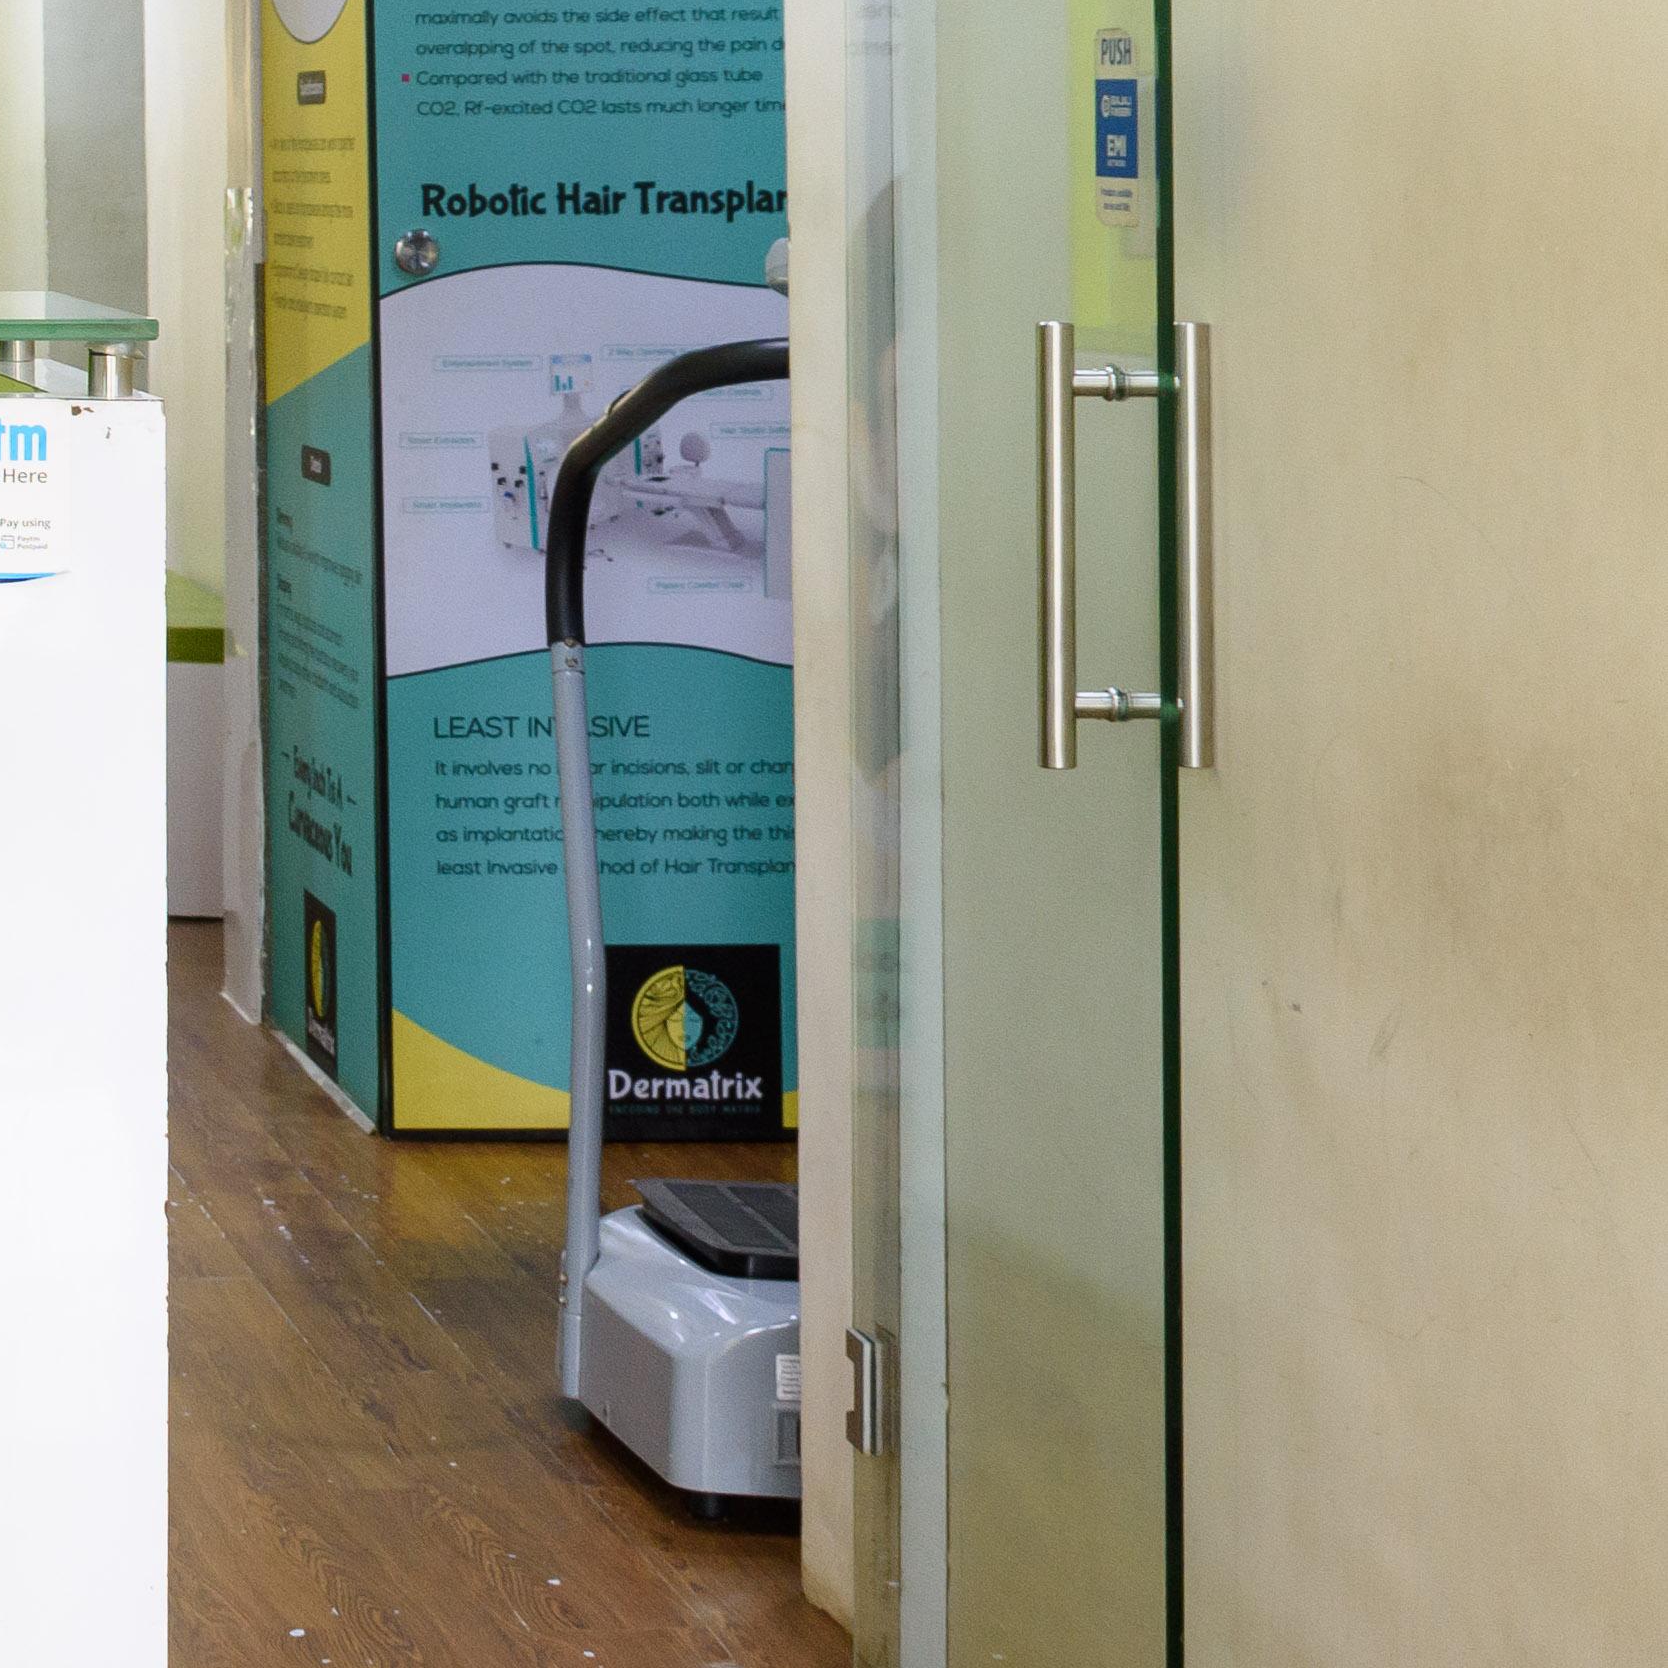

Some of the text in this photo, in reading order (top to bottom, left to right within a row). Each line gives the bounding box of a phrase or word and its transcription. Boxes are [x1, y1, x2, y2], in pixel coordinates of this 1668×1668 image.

[1101, 38, 1132, 65] PUSH
[416, 69, 763, 88] Compared with the traditional glass tube
[422, 183, 626, 217] Robotic Hair
[3, 469, 47, 483] Here
[0, 517, 19, 530] Pay
[22, 519, 51, 531] using
[434, 716, 518, 739] LEAST
[435, 759, 745, 776] It involves no incisions, slit or
[435, 792, 770, 815] human graft both while
[437, 858, 702, 875] least Invasive of Hair
[608, 1068, 762, 1099] Dermatrix
